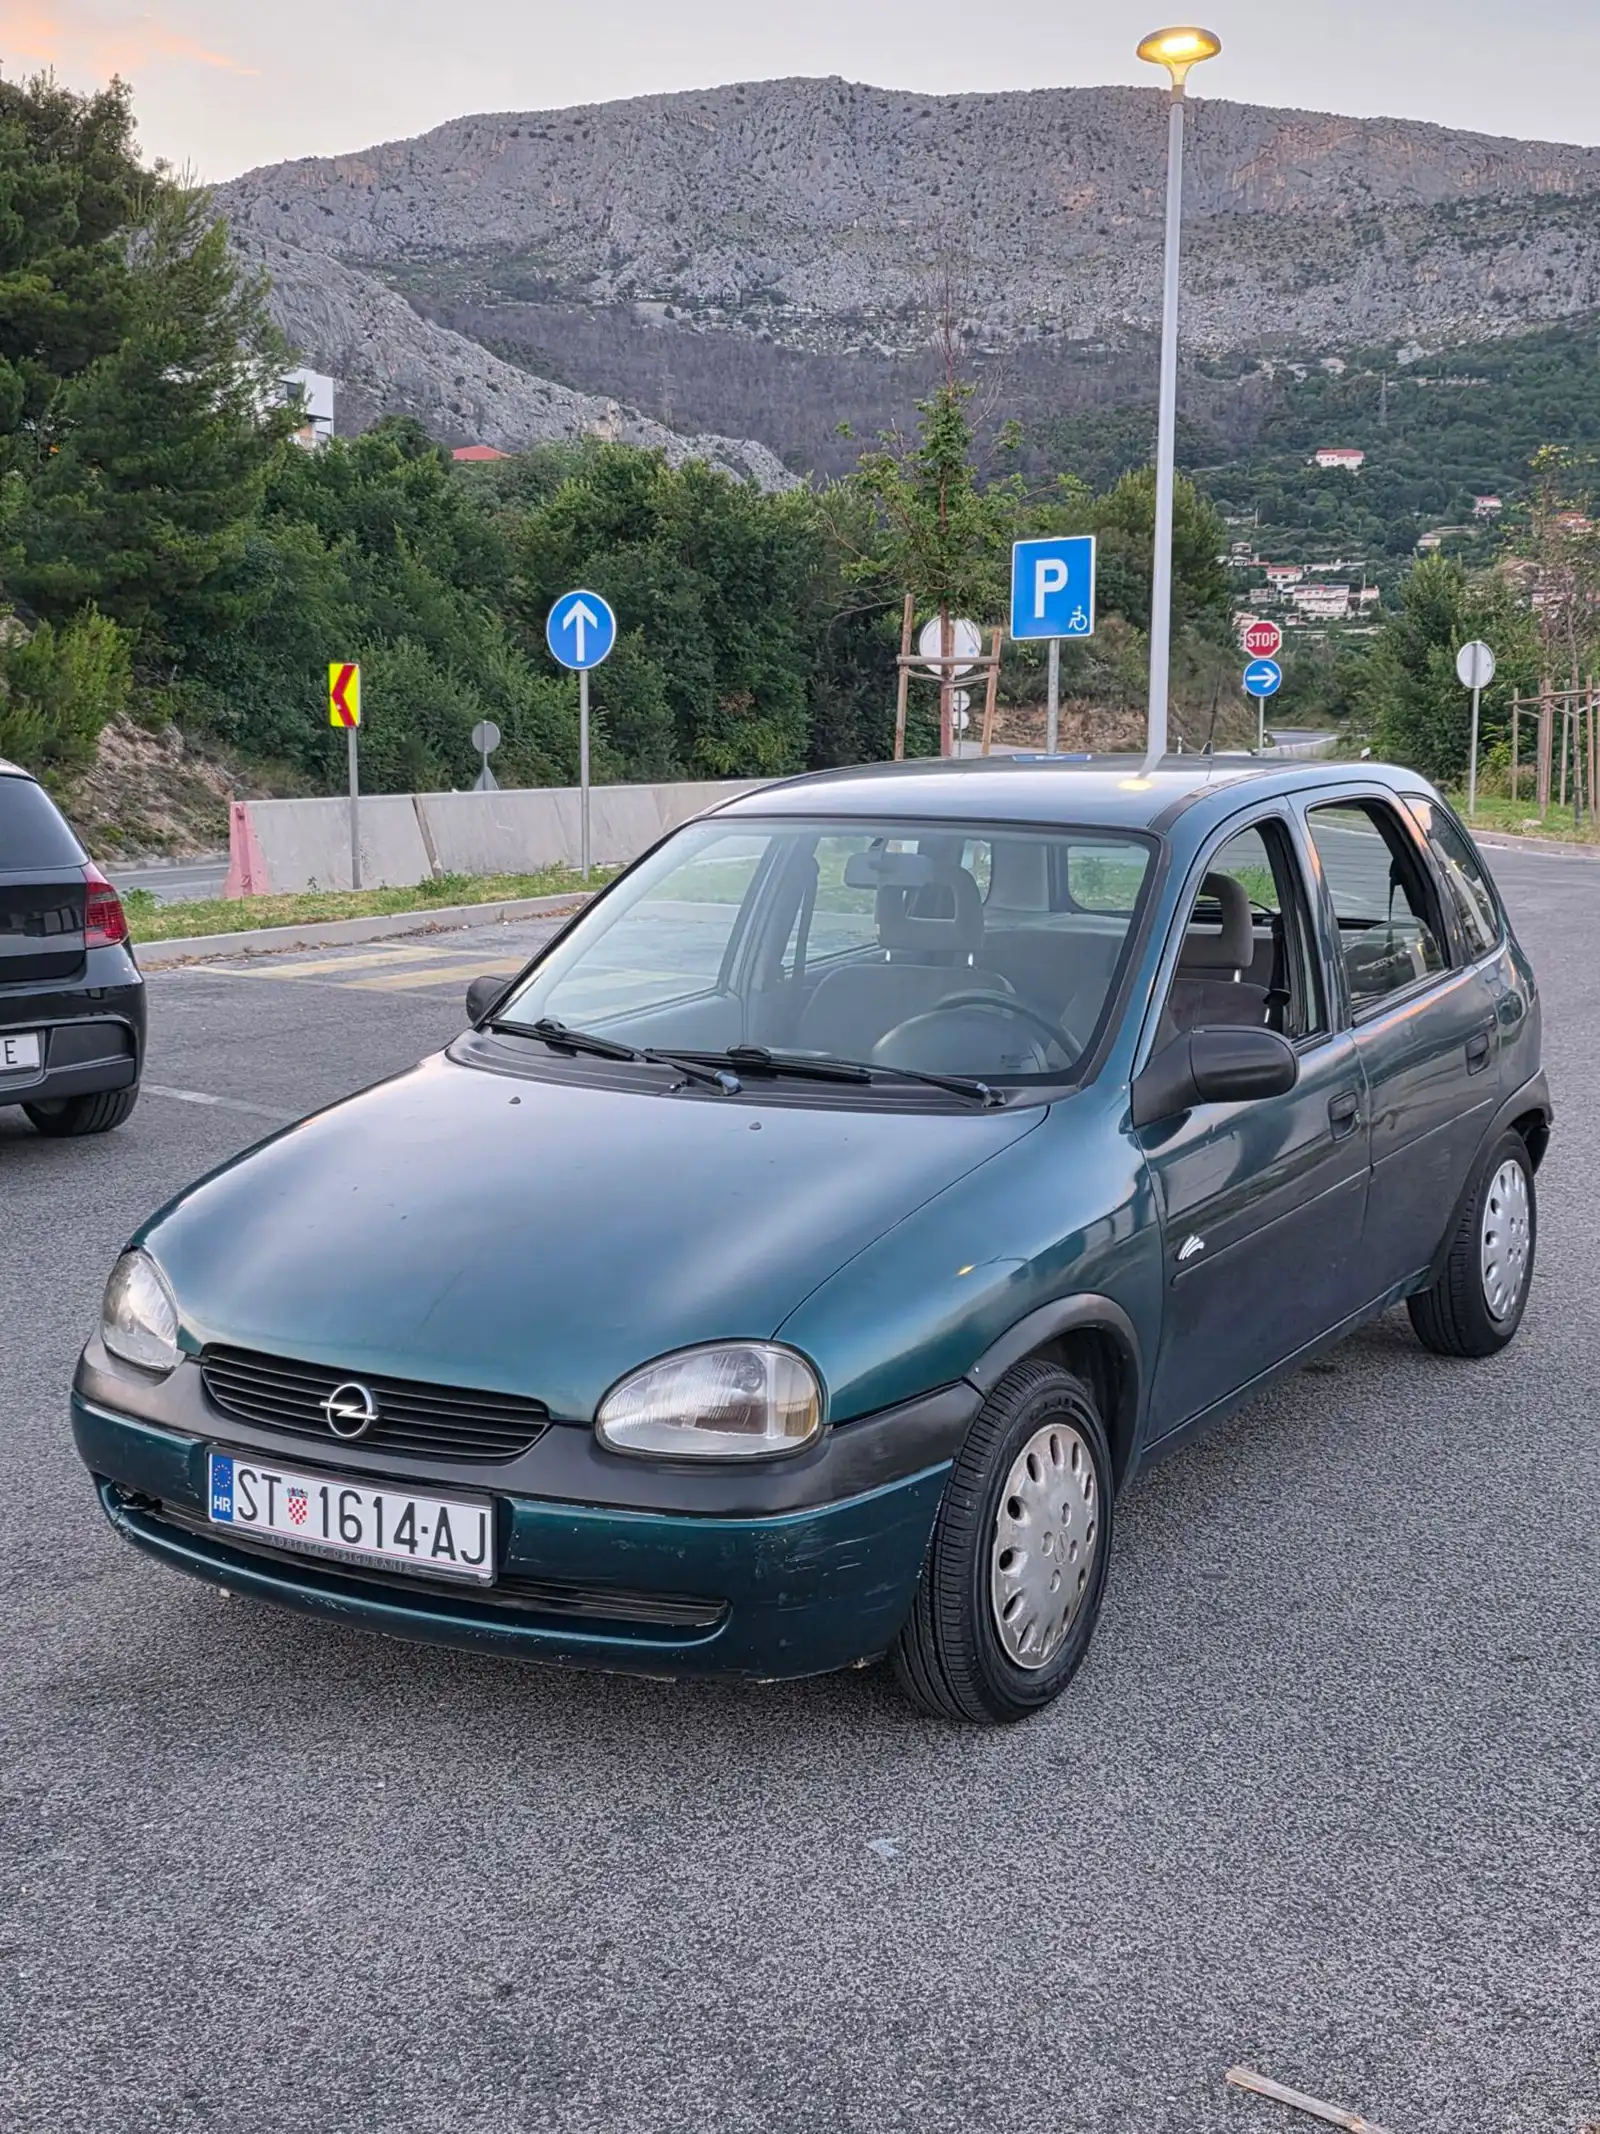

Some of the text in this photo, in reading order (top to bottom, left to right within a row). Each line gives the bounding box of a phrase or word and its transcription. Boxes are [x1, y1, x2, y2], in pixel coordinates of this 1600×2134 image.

[1034, 558, 1069, 618] P
[1247, 632, 1279, 648] STOP
[213, 1495, 232, 1513] HR
[237, 1468, 282, 1526] ST
